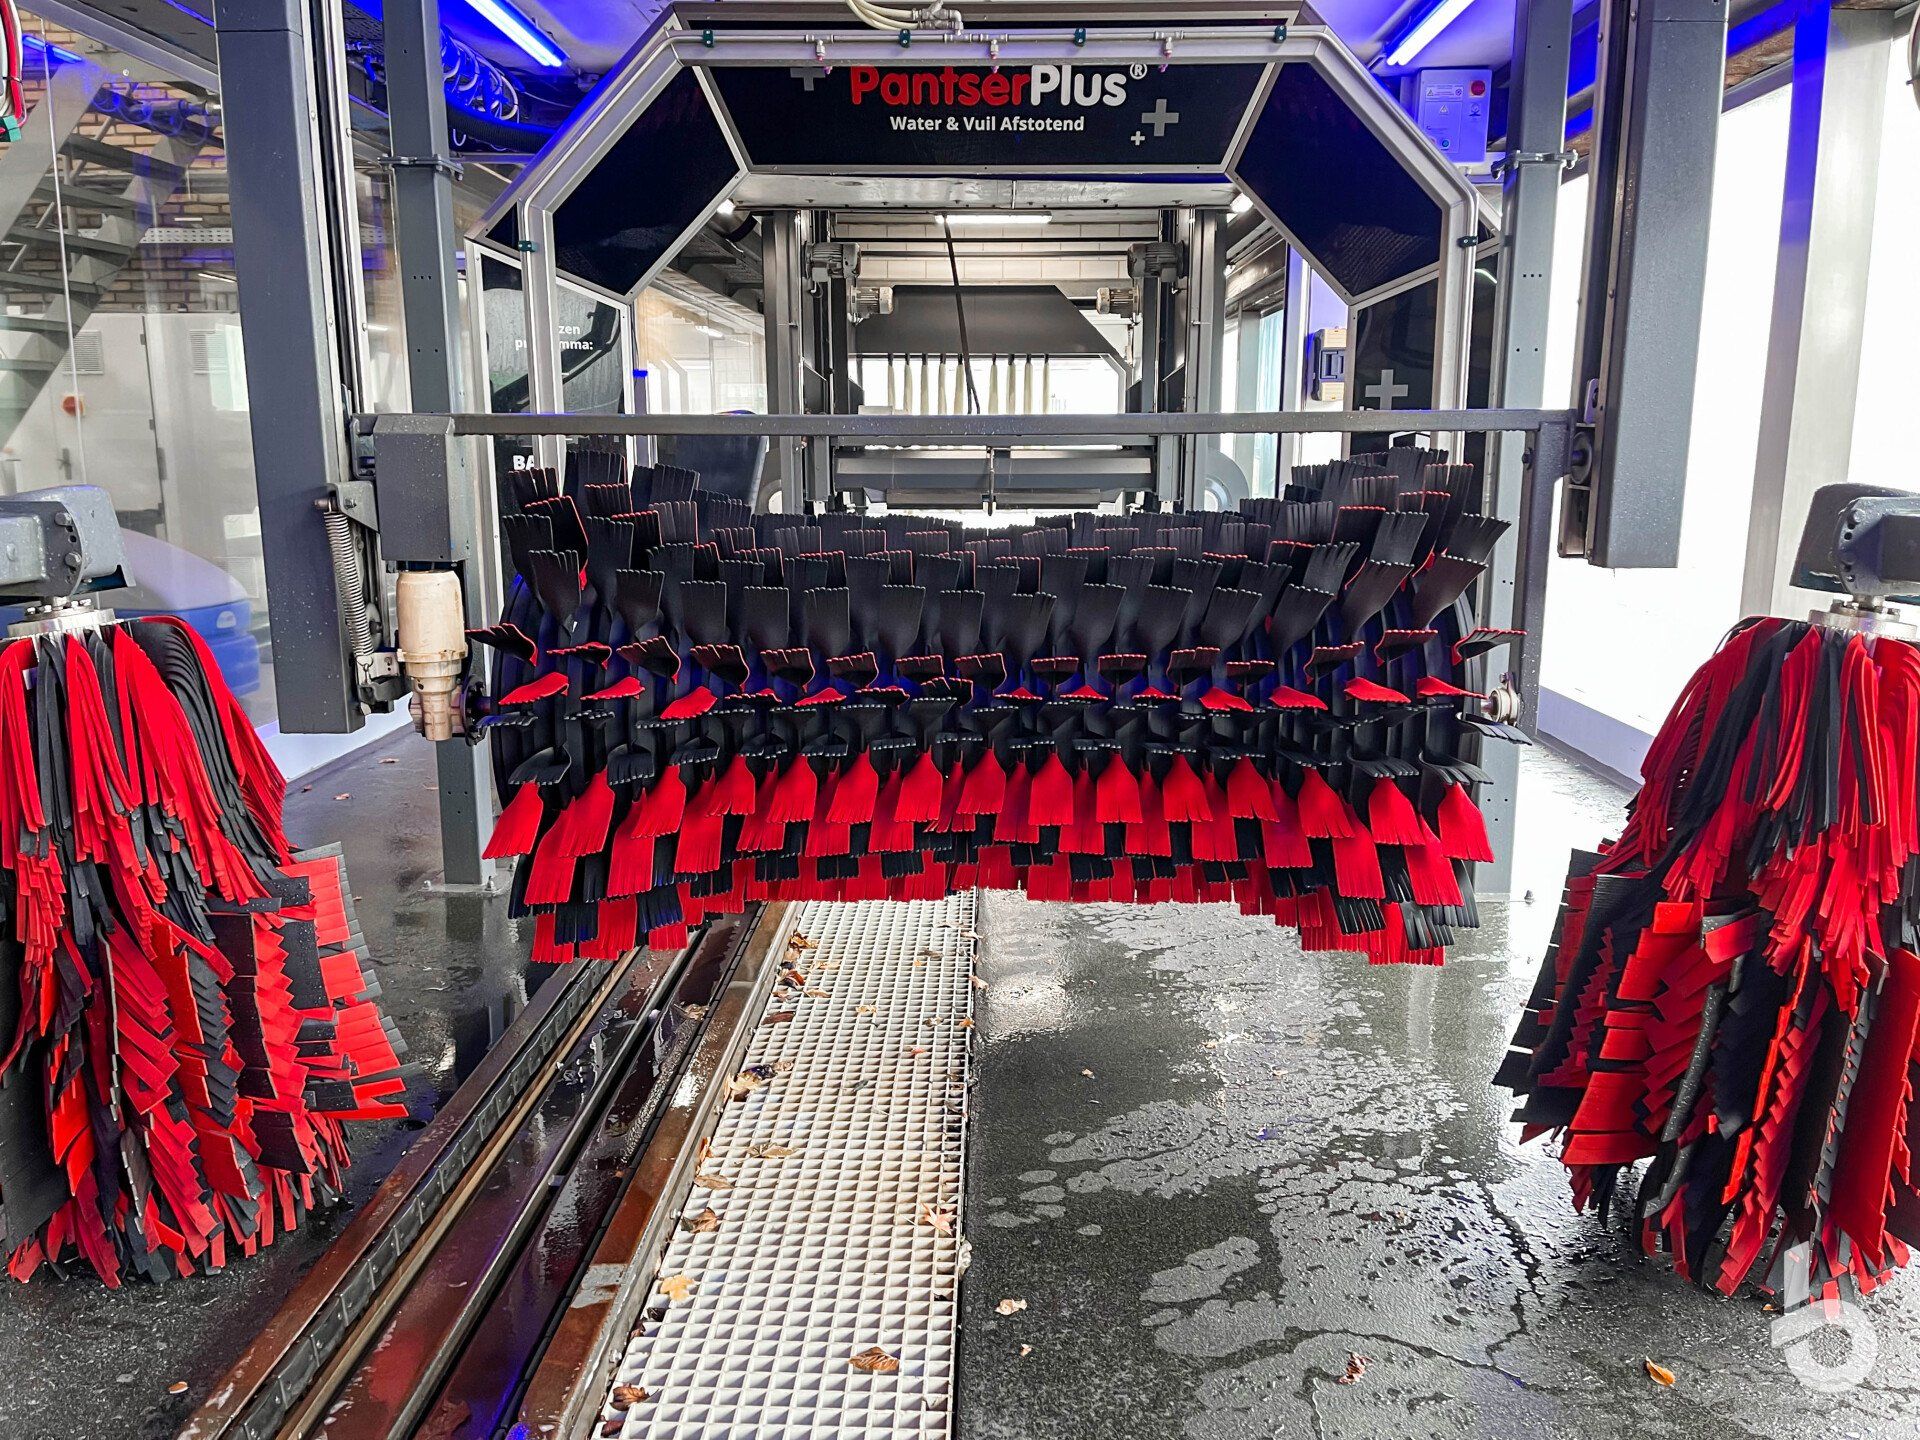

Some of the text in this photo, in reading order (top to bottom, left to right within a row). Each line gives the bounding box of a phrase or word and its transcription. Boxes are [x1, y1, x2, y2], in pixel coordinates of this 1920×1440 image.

[890, 116, 1085, 132] Water & Vuil Afstotend
